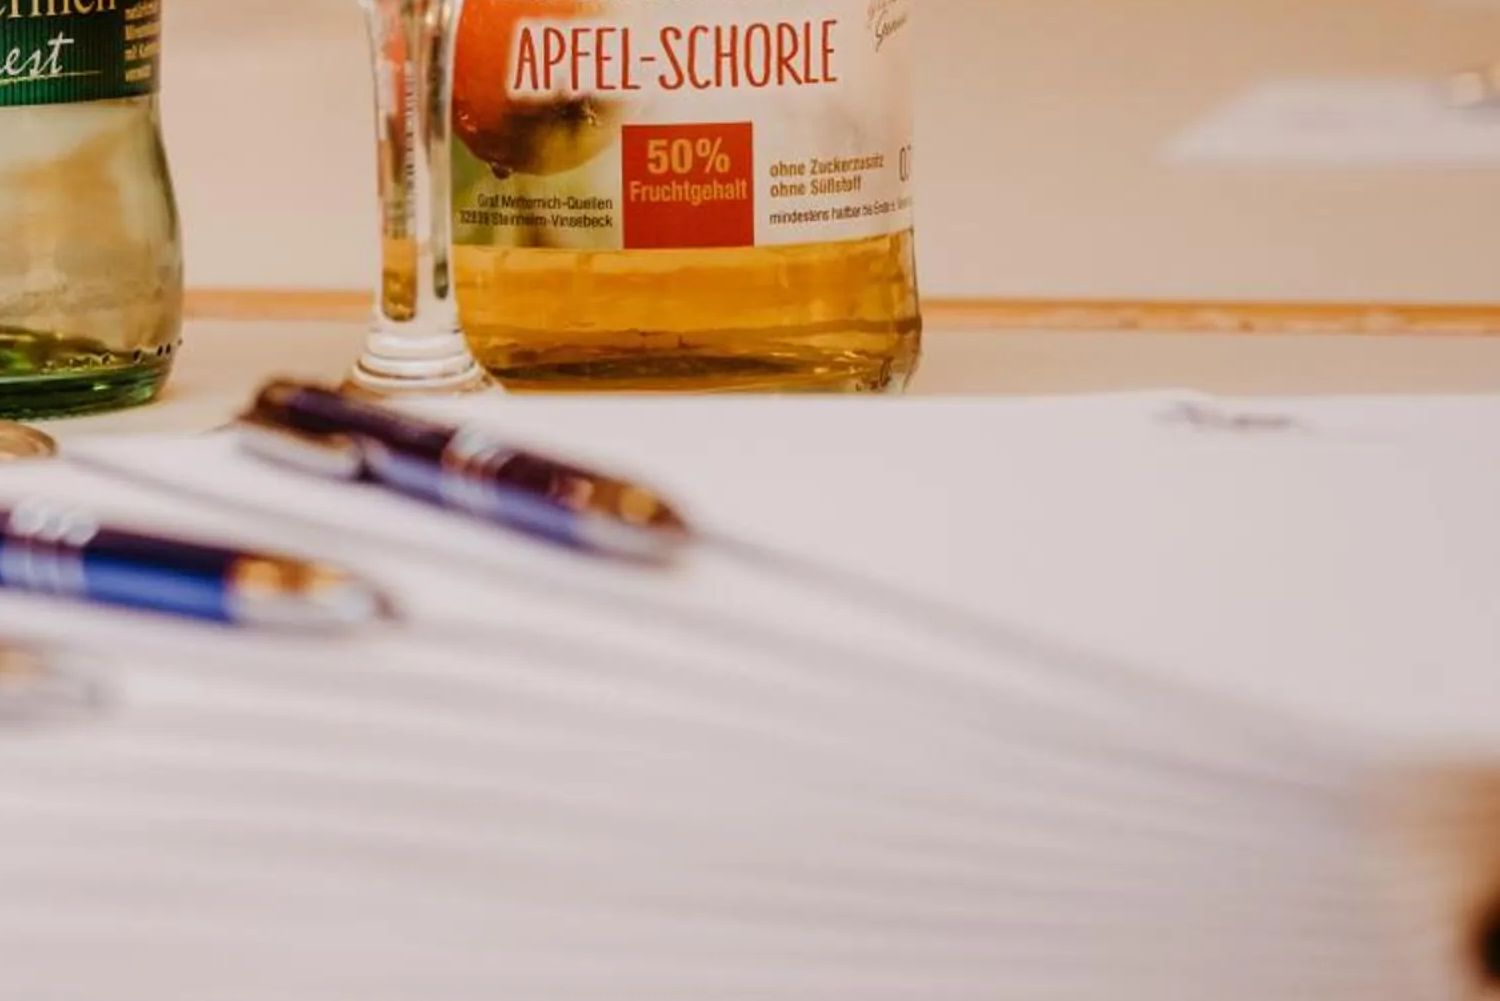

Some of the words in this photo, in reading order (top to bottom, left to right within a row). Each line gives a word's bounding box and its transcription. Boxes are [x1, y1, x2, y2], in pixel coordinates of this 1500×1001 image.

[514, 20, 838, 91] APFEL-SCHORLE
[647, 137, 731, 175] 50%
[769, 161, 805, 177] ohne
[630, 179, 748, 204] Fruchtgehalt
[769, 181, 805, 198] ohne
